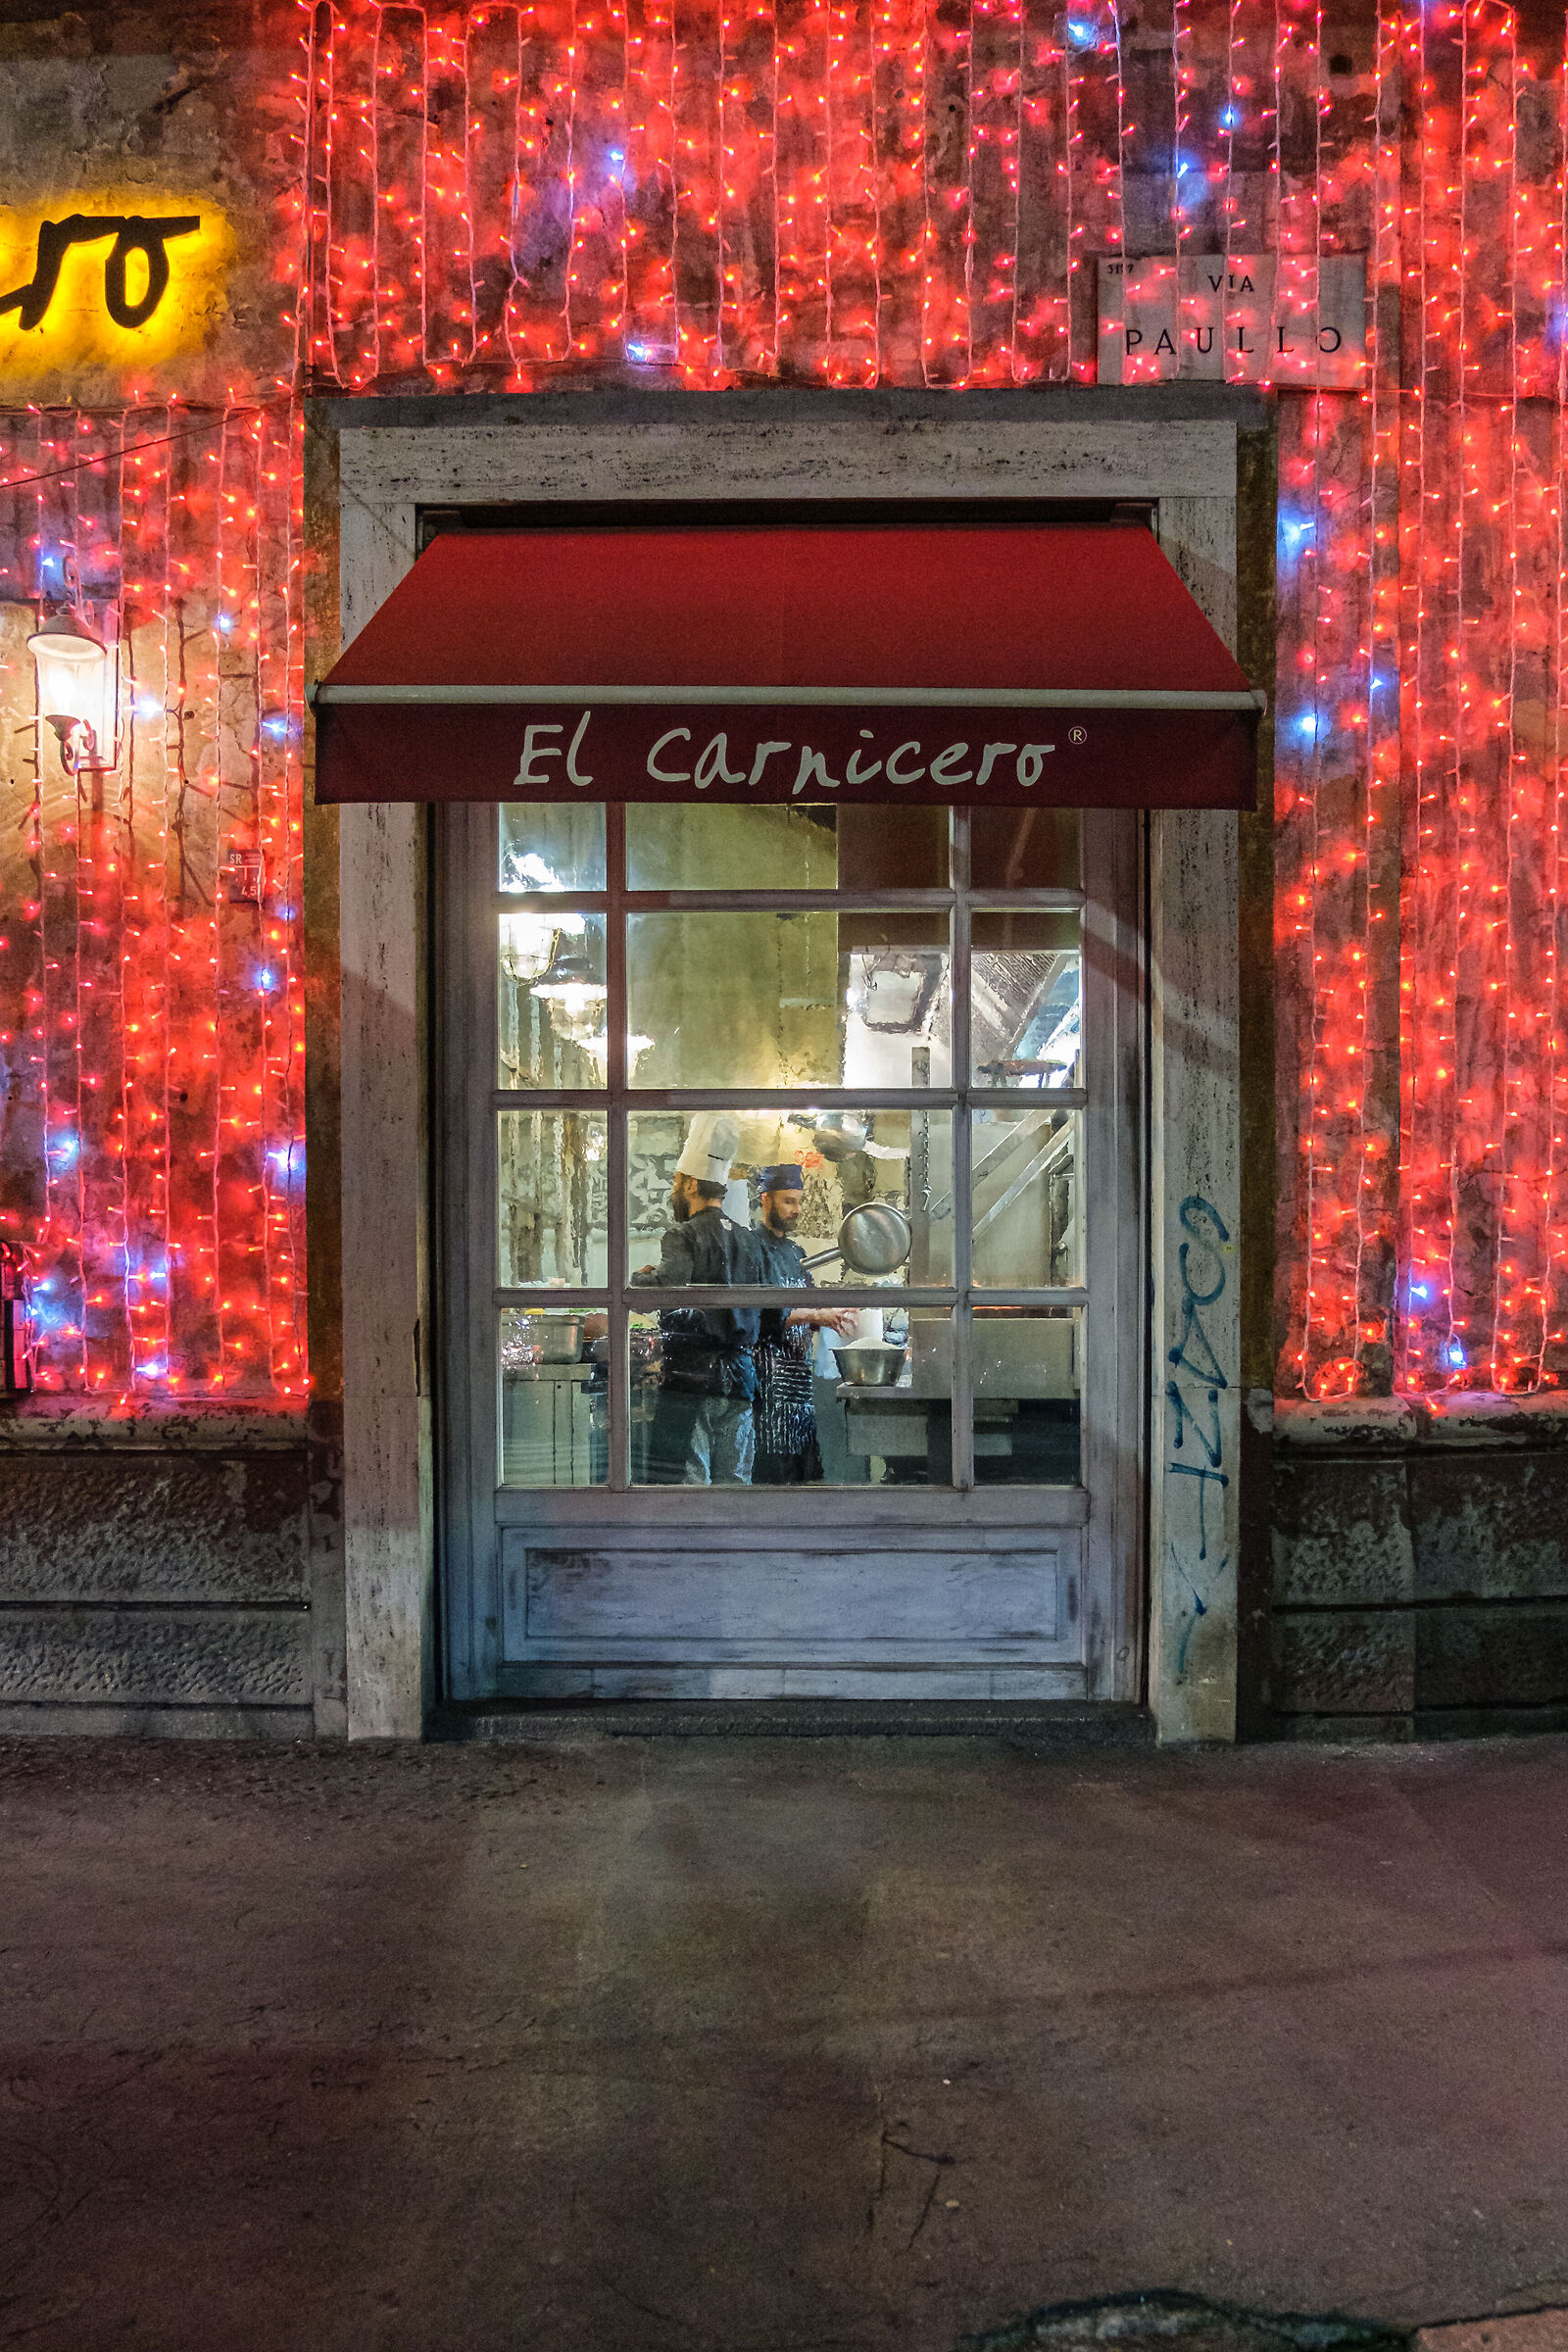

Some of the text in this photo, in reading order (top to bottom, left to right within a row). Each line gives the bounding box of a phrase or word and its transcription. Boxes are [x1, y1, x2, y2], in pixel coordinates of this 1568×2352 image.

[1207, 274, 1255, 293] VIA
[1126, 326, 1343, 356] PAULLO
[513, 710, 594, 786] El
[646, 726, 1055, 794] Carnicero
[229, 854, 242, 864] SR
